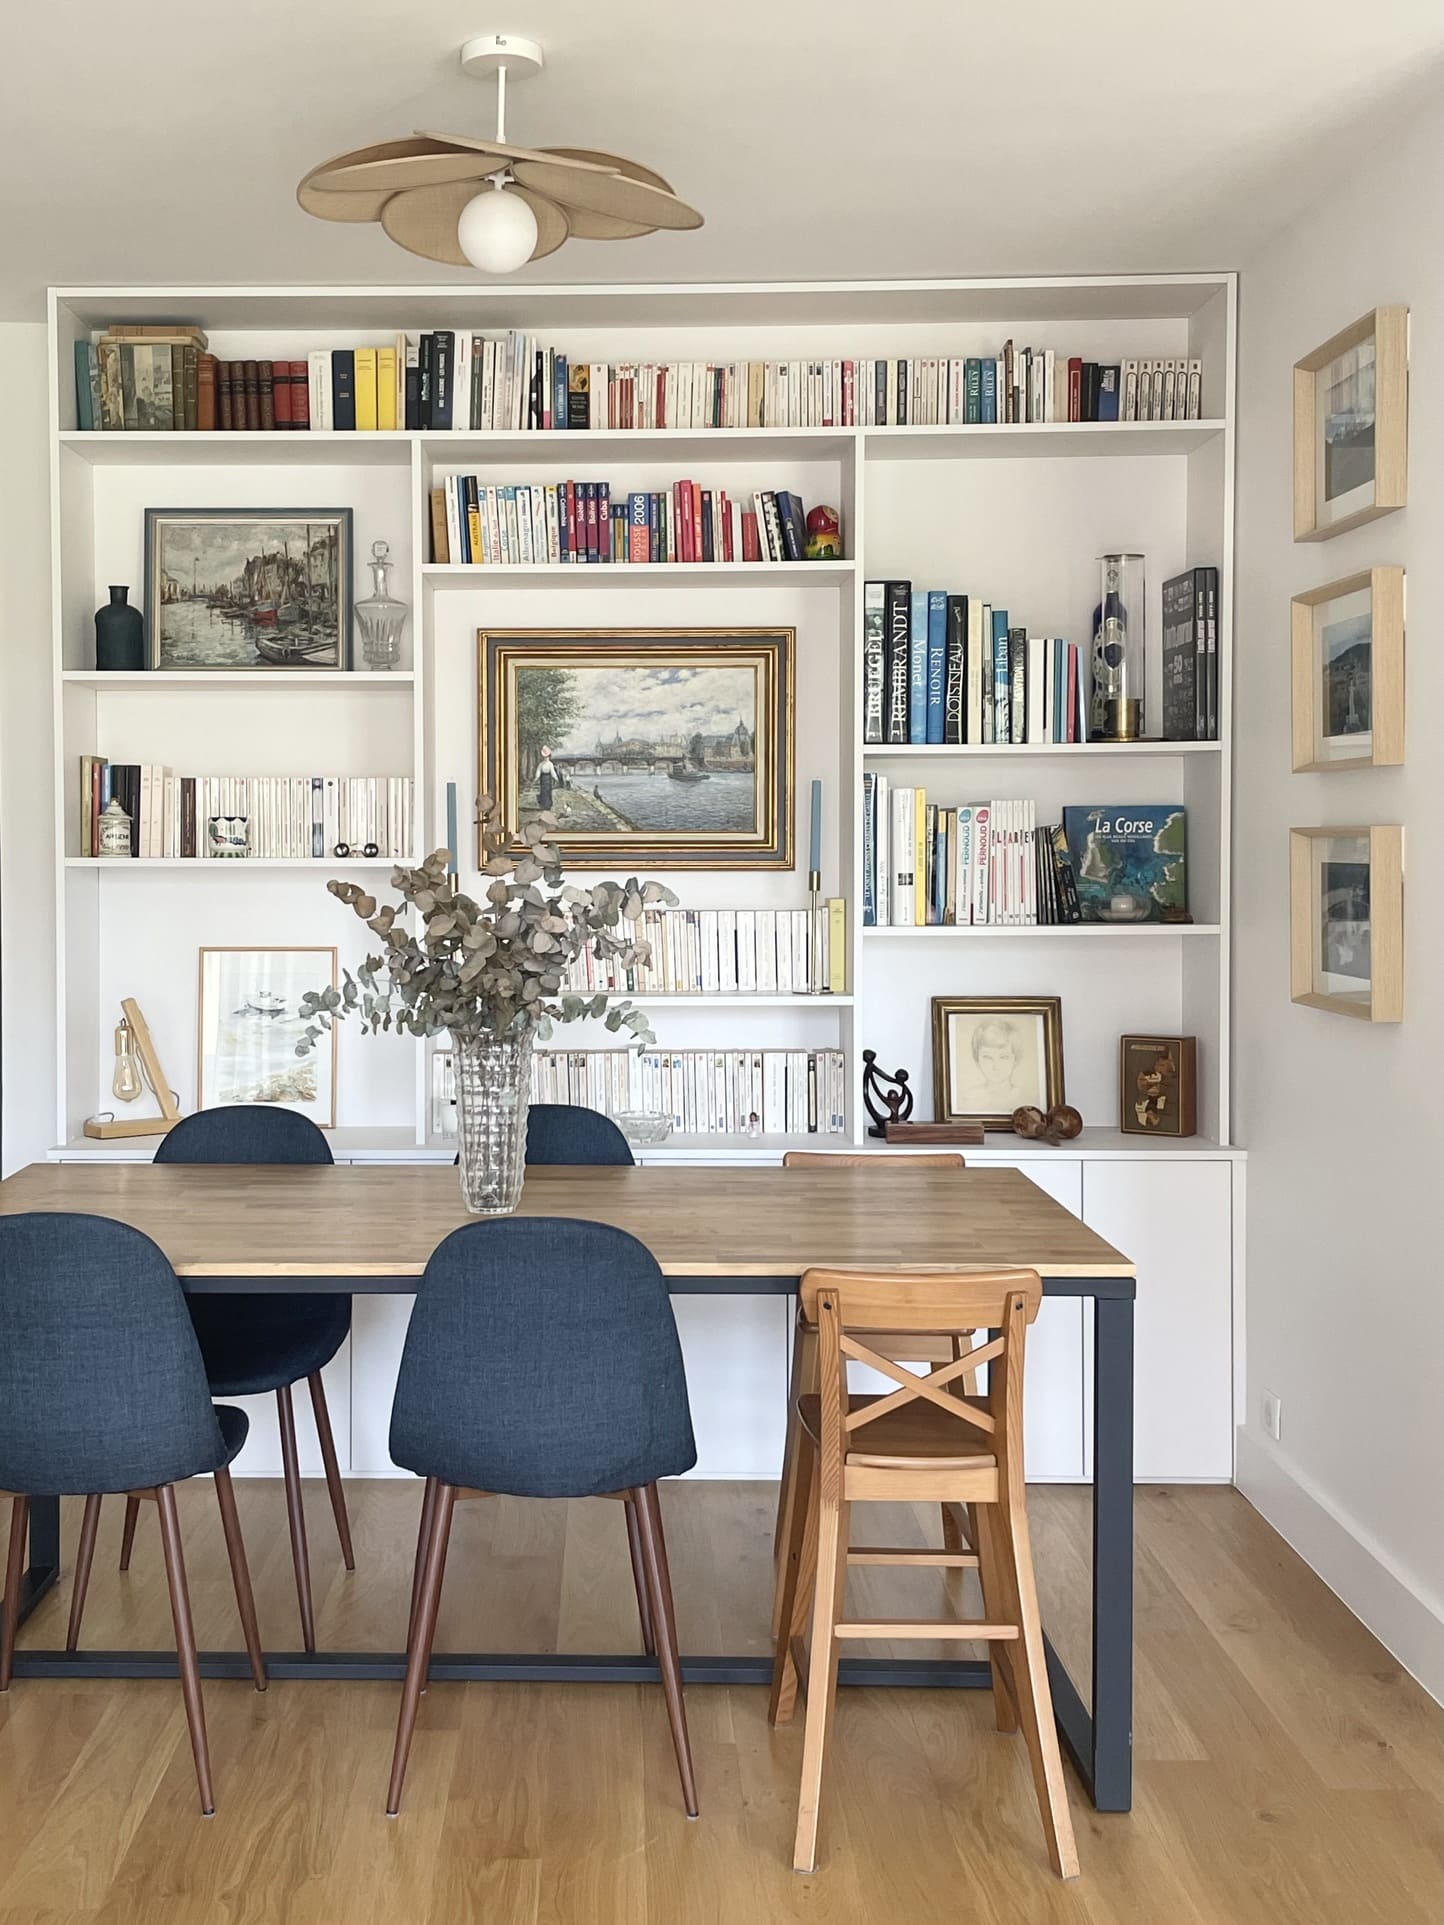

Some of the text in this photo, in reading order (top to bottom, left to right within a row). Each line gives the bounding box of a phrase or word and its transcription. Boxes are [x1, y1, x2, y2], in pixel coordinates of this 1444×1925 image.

[600, 500, 608, 521] Cuba
[634, 495, 645, 525] 2006
[491, 539, 499, 561] Italie
[522, 518, 530, 562] Allemagne
[550, 526, 558, 558] Belgique
[867, 629, 883, 718] BRUEGEL
[891, 601, 908, 722] REMBRANDT
[911, 639, 926, 687] Monet
[995, 636, 1008, 673] Liban
[930, 648, 944, 705] RENOIR
[947, 642, 963, 721] DOISNEAU
[962, 825, 970, 865] PERNOUD
[1095, 817, 1153, 833] La Corse
[979, 825, 987, 866] PERNOUD
